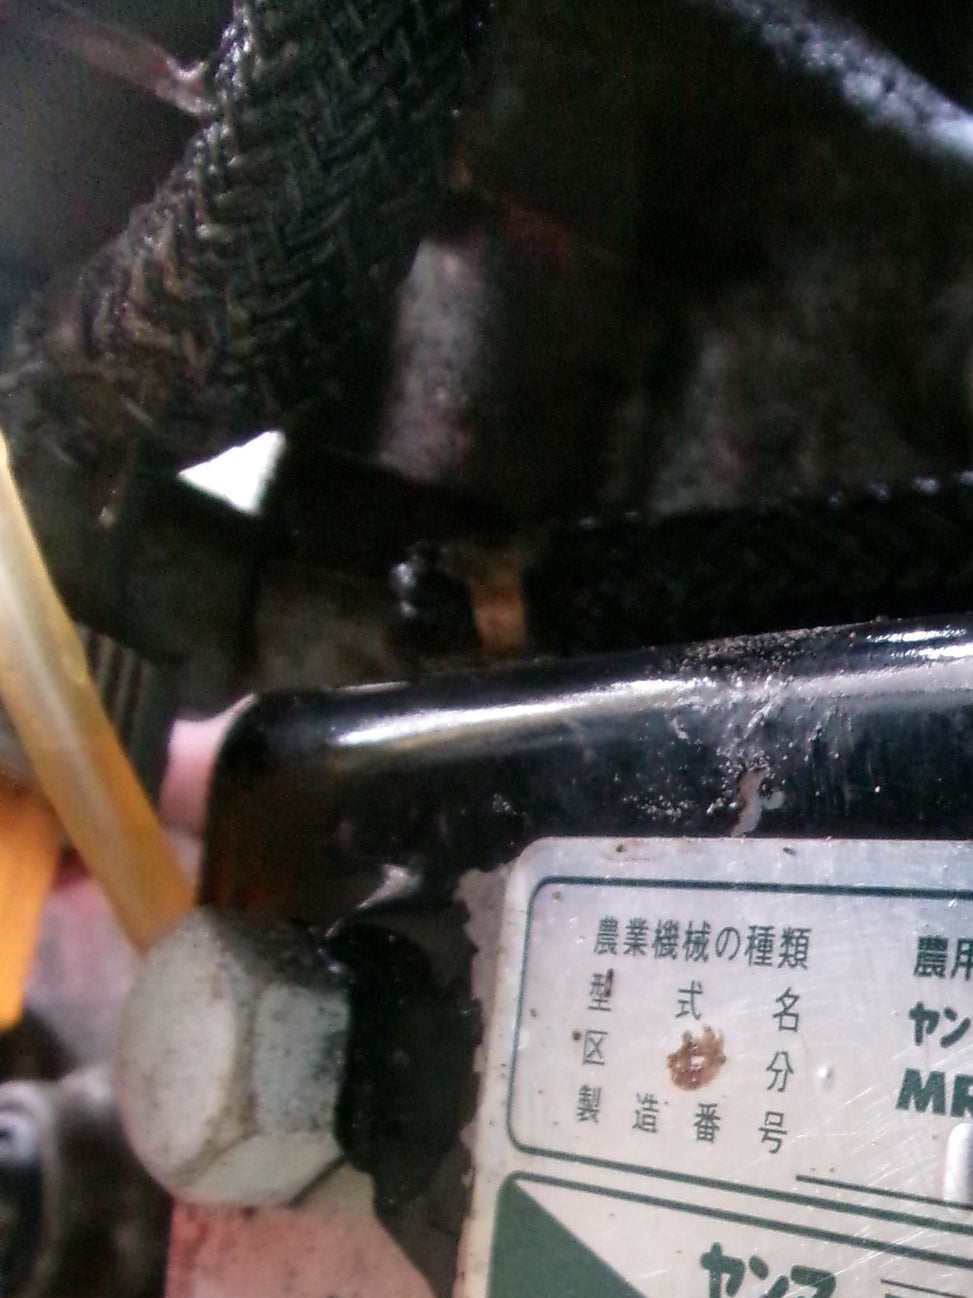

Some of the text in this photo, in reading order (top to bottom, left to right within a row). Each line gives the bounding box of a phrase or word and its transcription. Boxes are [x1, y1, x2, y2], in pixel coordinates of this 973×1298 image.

[594, 917, 811, 970] 農業機械の種類
